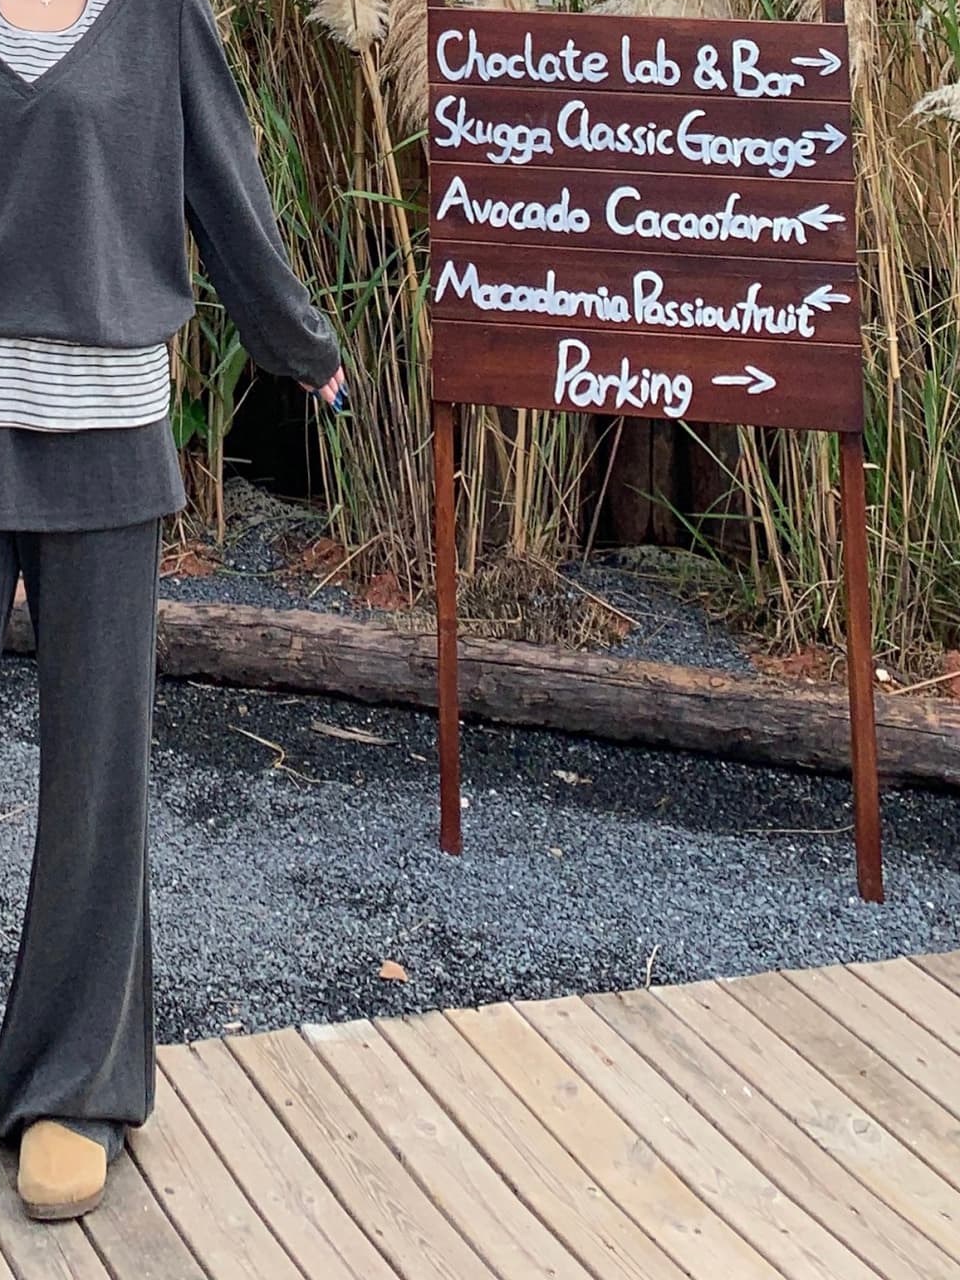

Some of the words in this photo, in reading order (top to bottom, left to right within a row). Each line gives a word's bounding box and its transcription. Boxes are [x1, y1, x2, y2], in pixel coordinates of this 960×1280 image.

[437, 28, 609, 82] Choclate
[621, 35, 681, 86] lab
[693, 44, 727, 91] &
[732, 39, 805, 98] Bar
[434, 95, 554, 164] Skugga
[557, 100, 673, 156] Classic
[677, 109, 816, 178] Garage
[437, 176, 589, 233] Avocado
[554, 338, 693, 418] Parking
